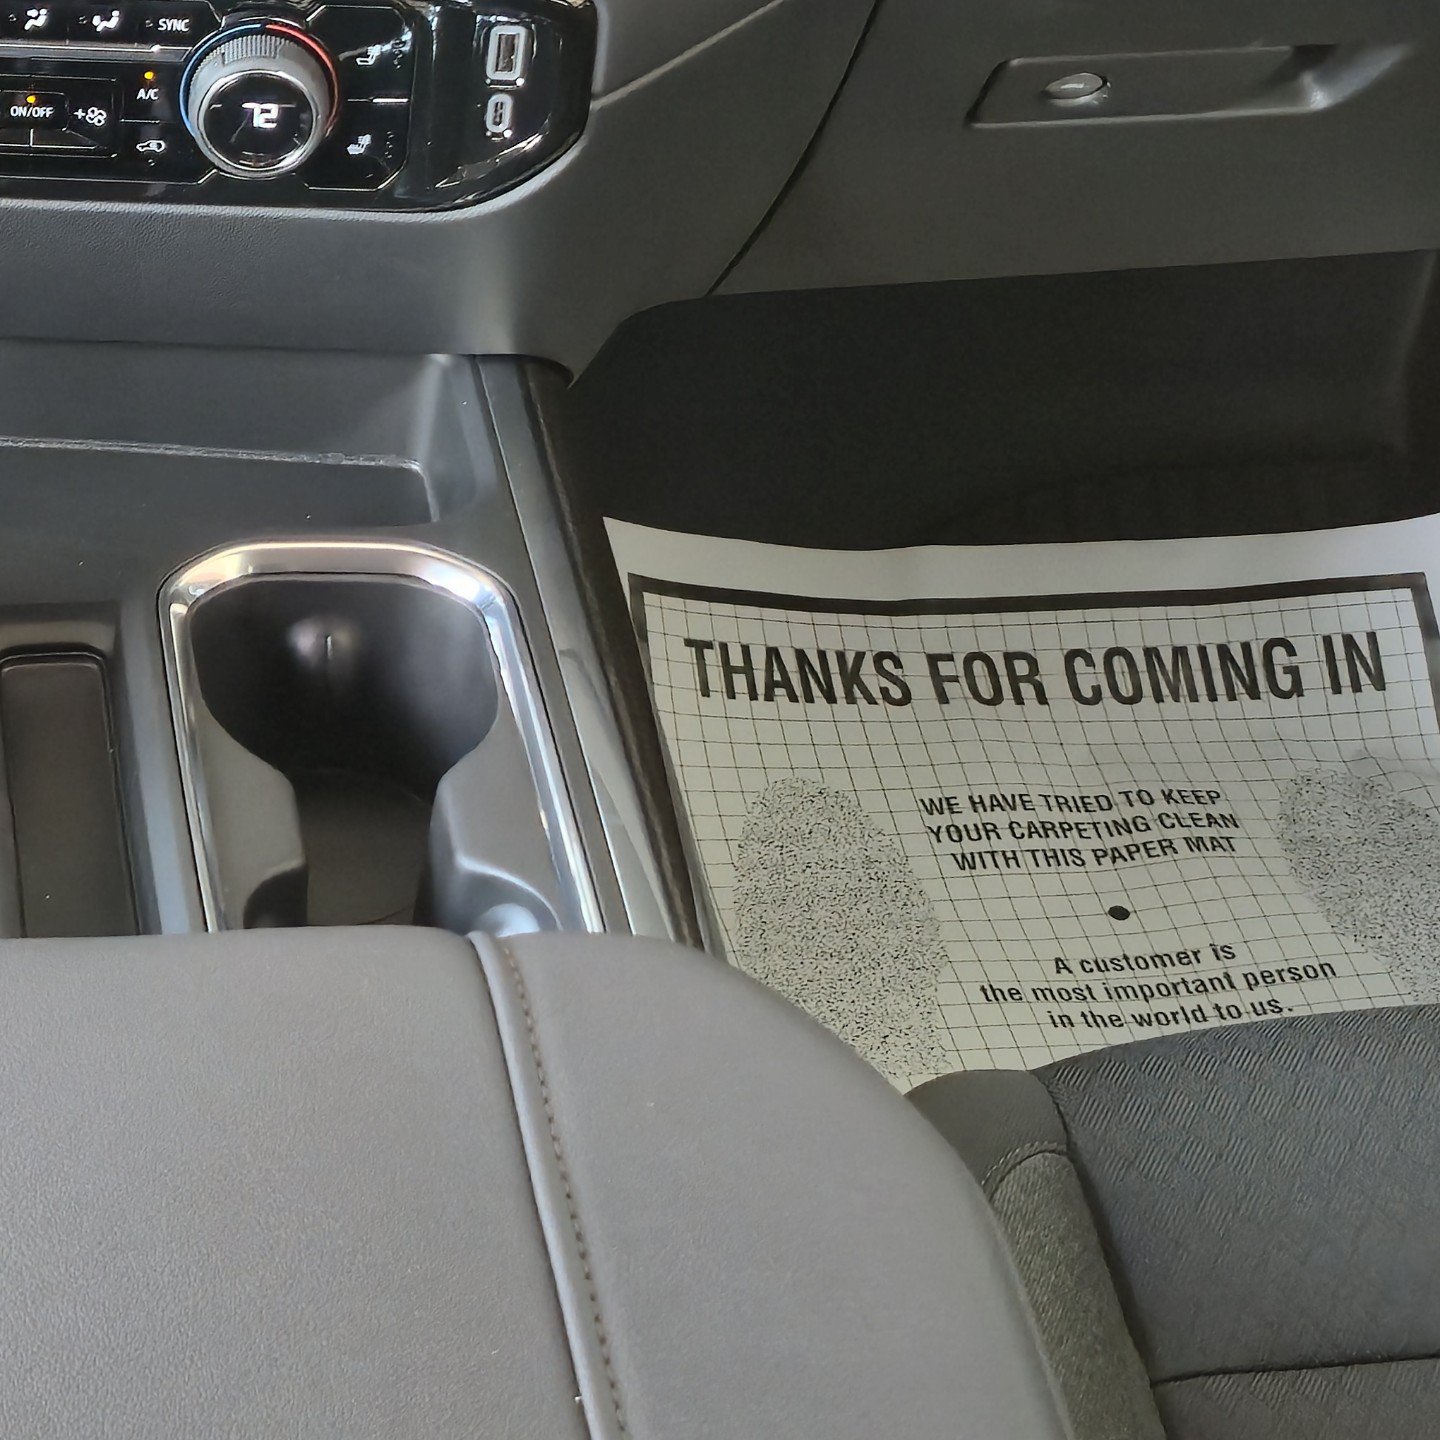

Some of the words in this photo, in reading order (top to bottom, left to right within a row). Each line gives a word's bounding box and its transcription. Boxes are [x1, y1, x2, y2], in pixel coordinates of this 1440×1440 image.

[158, 17, 190, 32] SYNC
[136, 87, 159, 101] A/C
[10, 104, 53, 119] ON/OFF
[241, 102, 279, 129] 72
[684, 637, 912, 707] THANKS
[930, 649, 1049, 707] FOR
[1066, 636, 1303, 707] COMING
[1324, 630, 1389, 694] IN
[918, 795, 963, 816] WE
[968, 793, 1037, 813] HAVE
[1038, 793, 1114, 814] TRIED
[1118, 789, 1155, 808] TO
[1160, 788, 1222, 806] KEEP
[926, 821, 1002, 844] YOUR
[1008, 815, 1152, 840] CARPETING
[1158, 811, 1240, 830] CLEAN
[950, 848, 1022, 871] WITH
[1024, 847, 1086, 868] THIS
[1091, 837, 1179, 866] PAPER
[1182, 835, 1237, 854] MAT
[1054, 956, 1073, 975] A
[1080, 949, 1203, 974] customer
[1211, 942, 1237, 961] is
[979, 984, 1023, 1003] the
[1031, 983, 1097, 1002] most
[1106, 972, 1237, 1003] important
[1242, 960, 1337, 991] person
[1048, 1010, 1072, 1028] in
[1080, 1010, 1125, 1030] the
[1132, 1005, 1209, 1027] world
[1216, 1001, 1243, 1021] to
[1250, 997, 1294, 1017] us.
